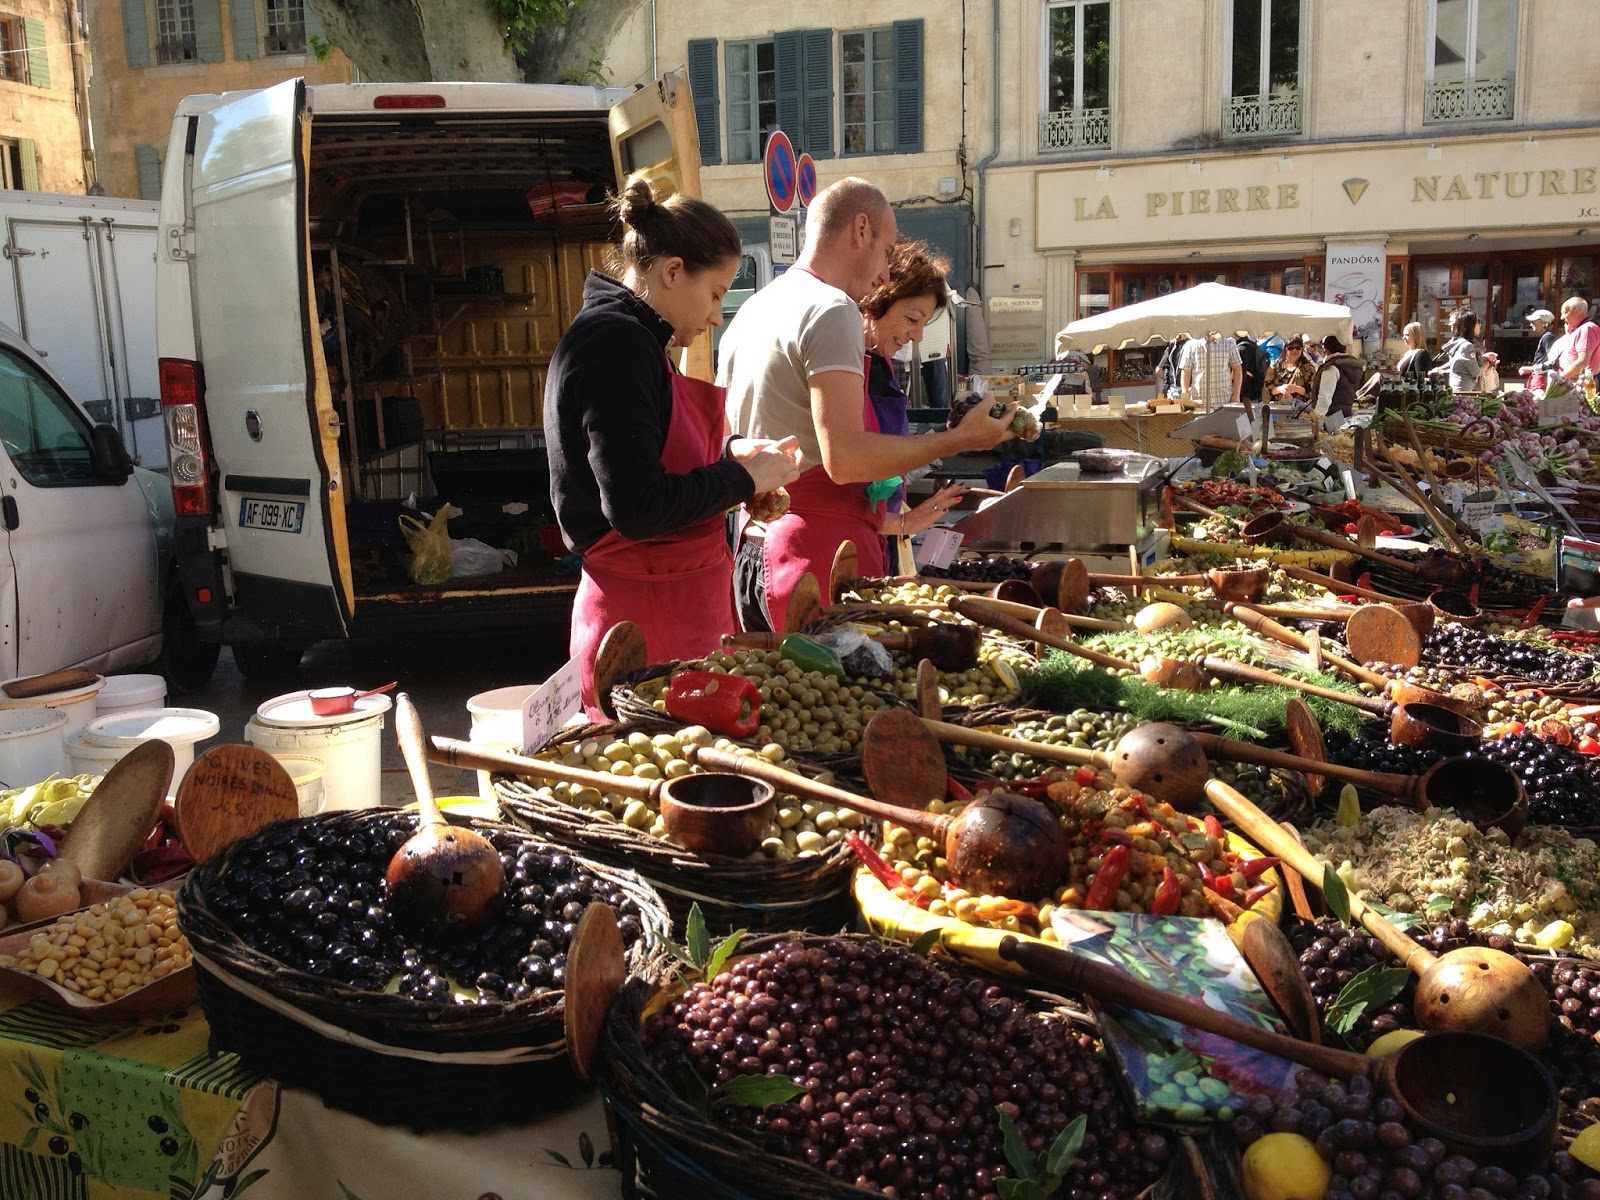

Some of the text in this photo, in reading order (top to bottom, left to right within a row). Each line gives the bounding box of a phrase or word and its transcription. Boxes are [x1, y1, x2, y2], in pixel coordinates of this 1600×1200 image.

[1073, 166, 1598, 221] LA PIERRE NATURE
[1331, 255, 1380, 265] PANDORA
[246, 502, 295, 528] AF-099-XC
[208, 755, 272, 776] OLIVES
